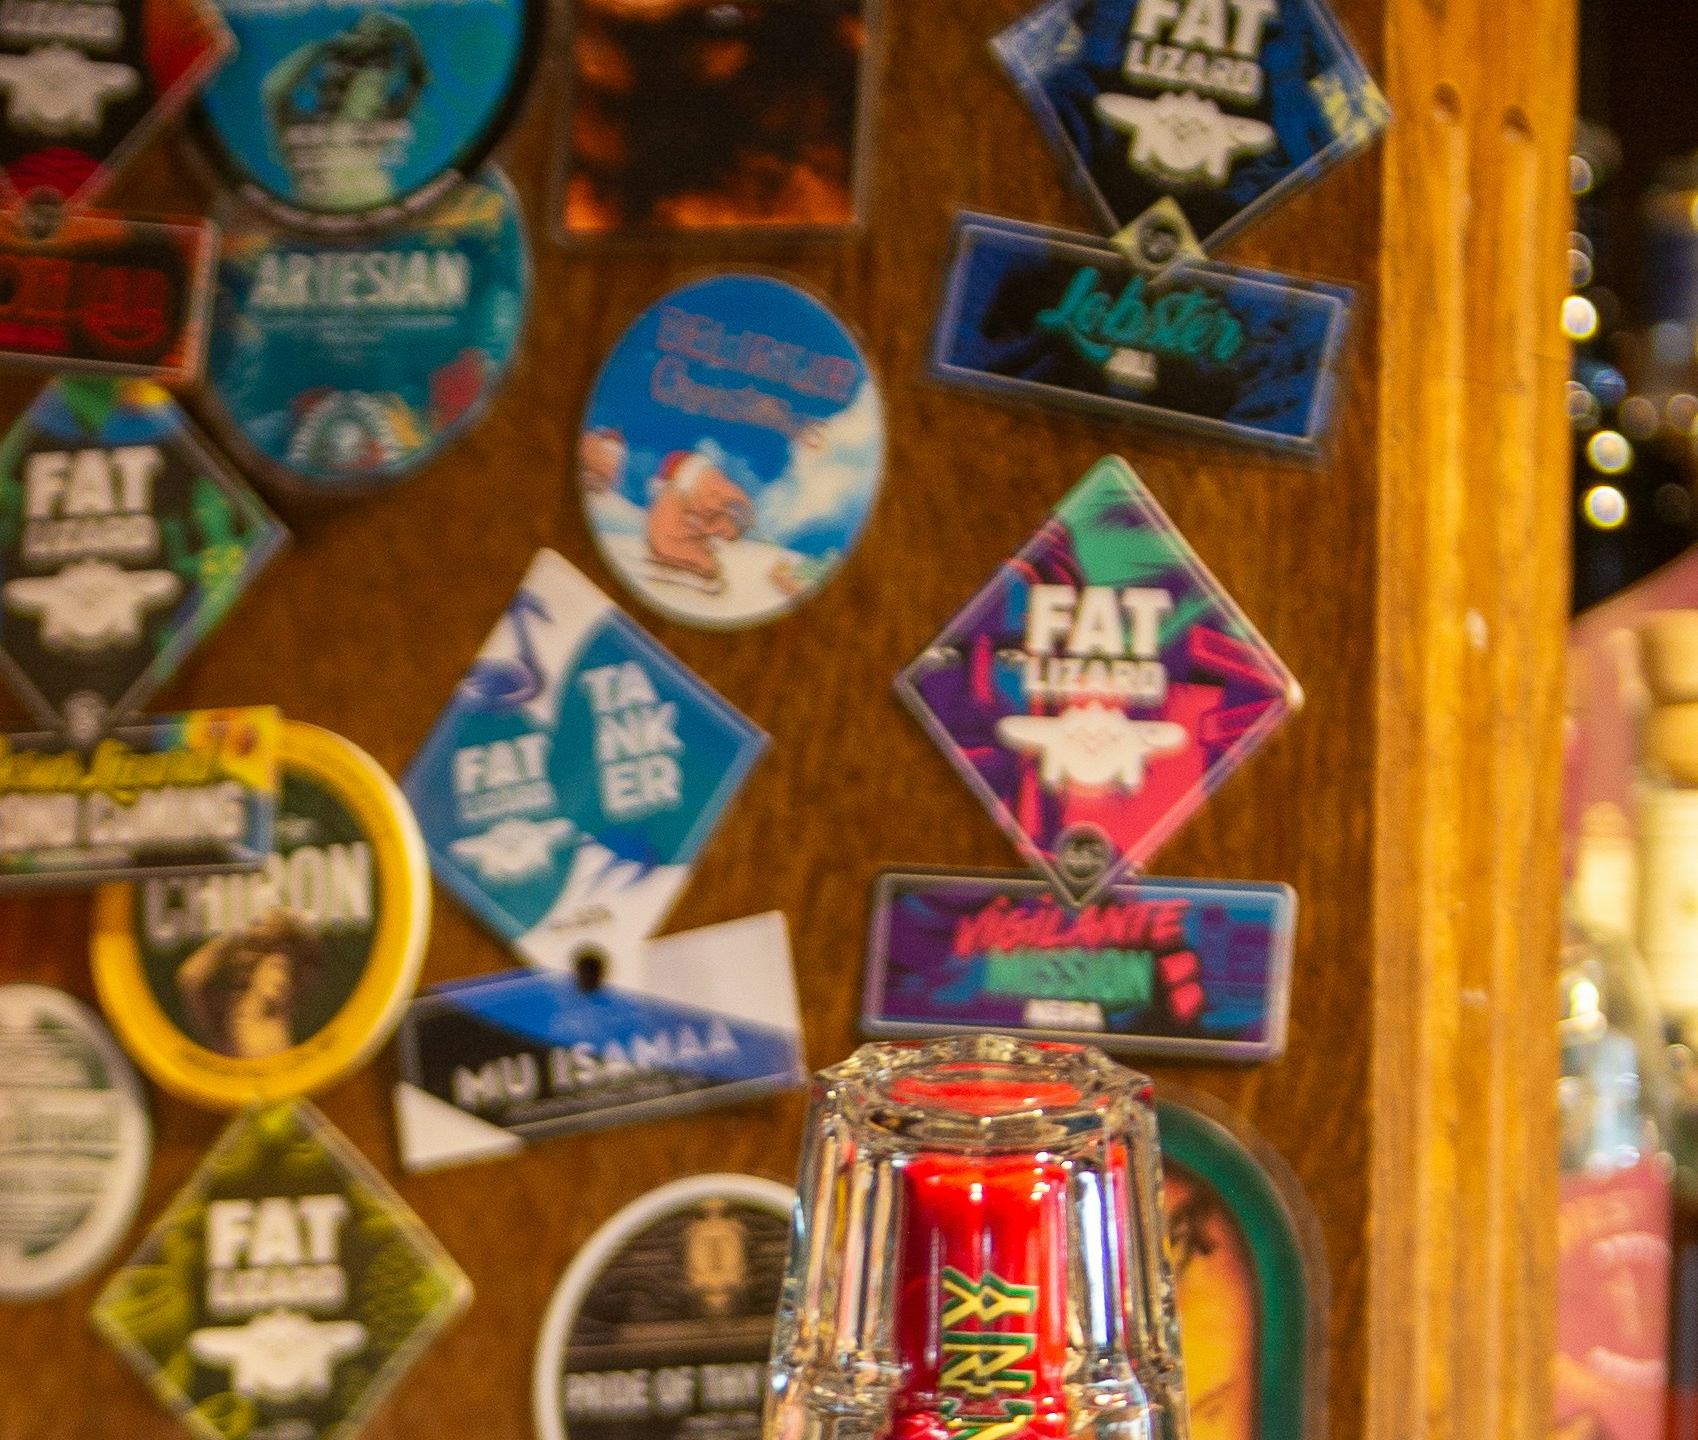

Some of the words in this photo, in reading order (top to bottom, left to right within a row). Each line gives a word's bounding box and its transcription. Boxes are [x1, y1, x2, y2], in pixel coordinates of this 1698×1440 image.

[1122, 41, 1266, 106] LIZARD
[246, 250, 473, 312] ARTESIAN
[21, 443, 166, 519] FAT
[1024, 582, 1175, 660] FAT
[1021, 655, 1171, 709] LIZARD
[451, 732, 555, 796] FAT
[142, 837, 373, 956] CHIRON
[952, 893, 1193, 959] VIGILANTE
[450, 1051, 541, 1115] MU
[205, 1192, 352, 1269] FAT
[205, 1262, 349, 1318] LIZARD
